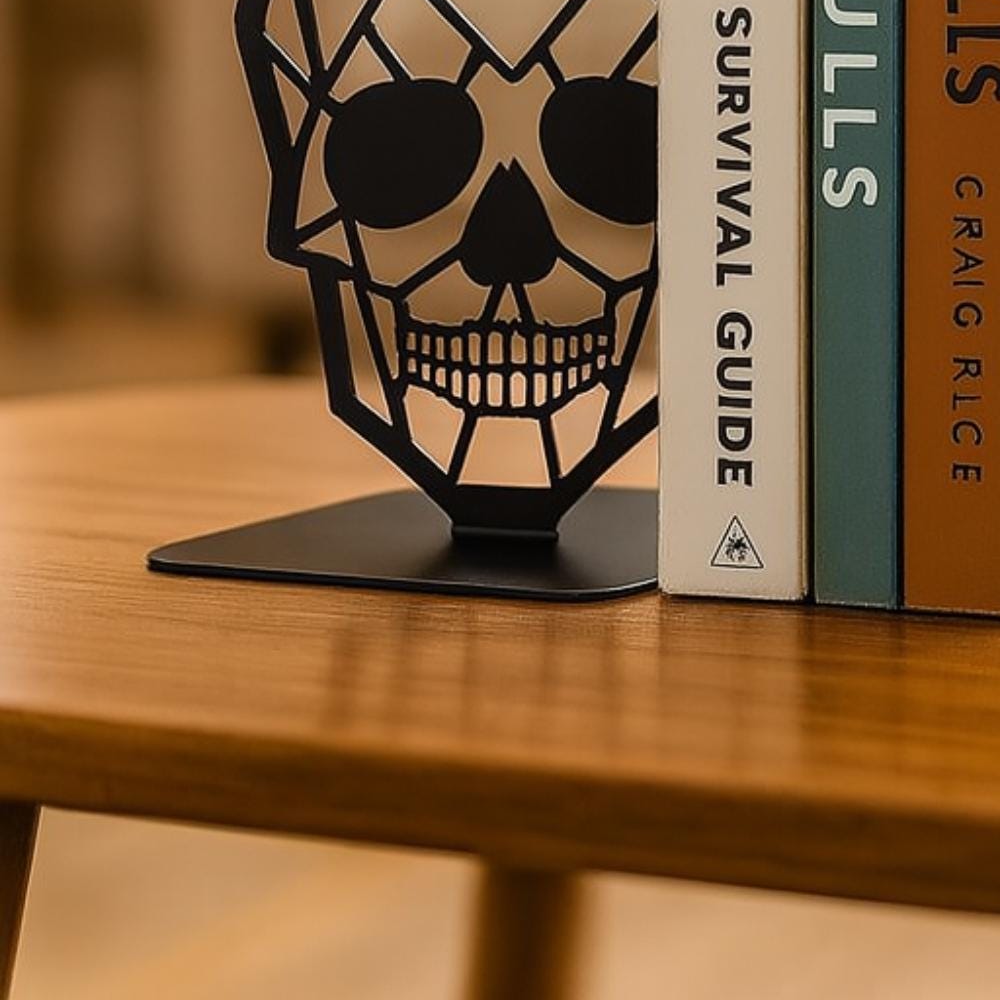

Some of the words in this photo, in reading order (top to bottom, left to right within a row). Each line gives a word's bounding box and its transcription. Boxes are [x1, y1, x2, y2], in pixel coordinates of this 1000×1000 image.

[715, 6, 753, 287] SURVIVAL
[952, 175, 984, 329] CRAIG
[716, 310, 753, 487] GUIDE
